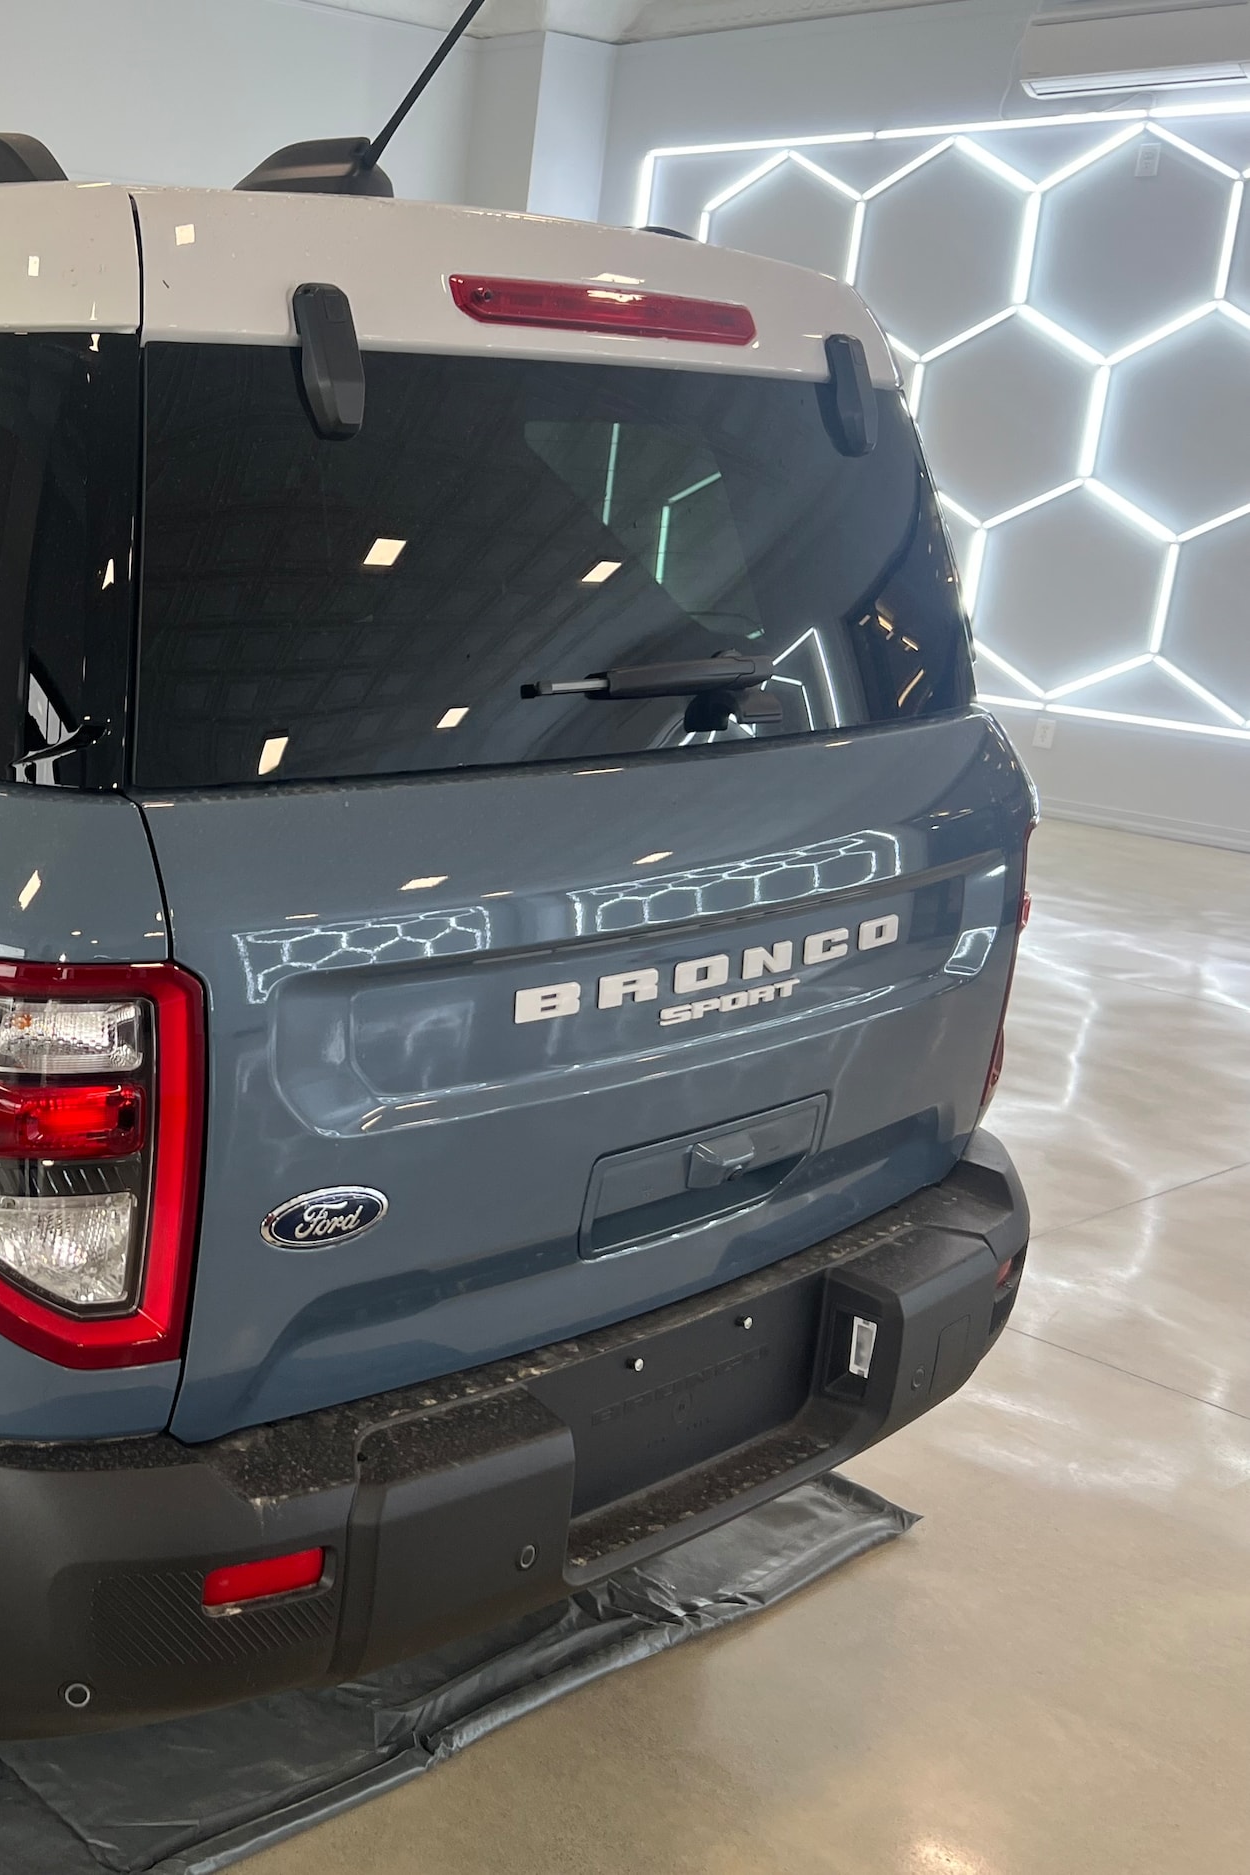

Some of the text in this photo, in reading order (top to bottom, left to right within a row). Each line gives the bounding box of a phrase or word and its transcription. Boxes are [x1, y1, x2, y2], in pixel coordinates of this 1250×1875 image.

[514, 914, 899, 1024] BRONCO
[660, 968, 800, 1027] SPORT
[294, 1201, 364, 1239] Ford
